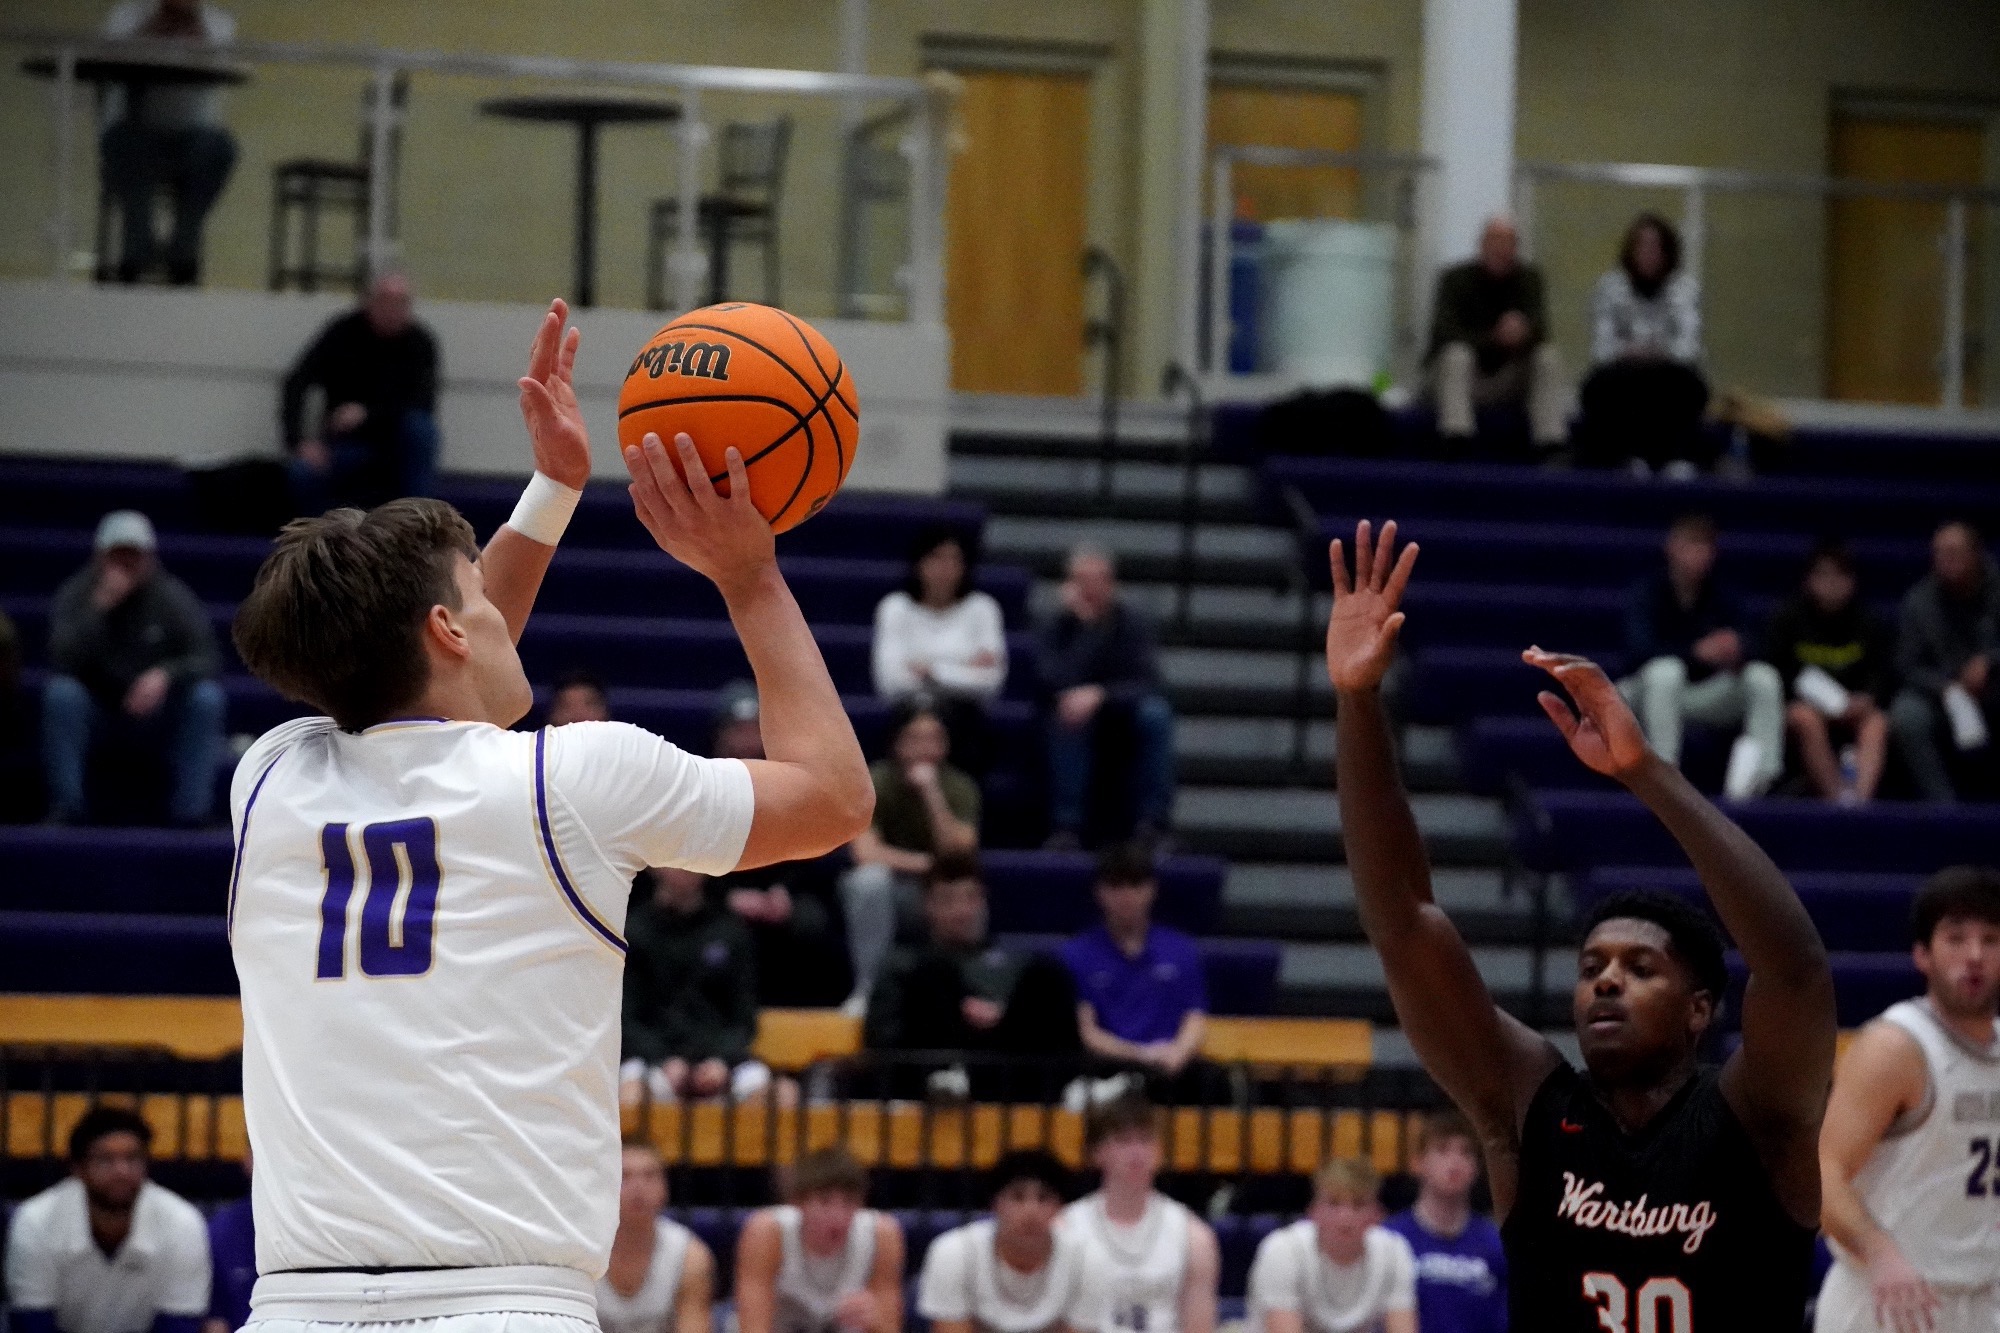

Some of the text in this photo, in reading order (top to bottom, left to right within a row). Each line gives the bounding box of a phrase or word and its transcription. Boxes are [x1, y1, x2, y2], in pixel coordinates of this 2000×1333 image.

[623, 341, 731, 384] Wilso
[314, 816, 445, 982] 10
[1557, 1171, 1718, 1254] Wartburg
[1582, 1271, 1694, 1333] 30
